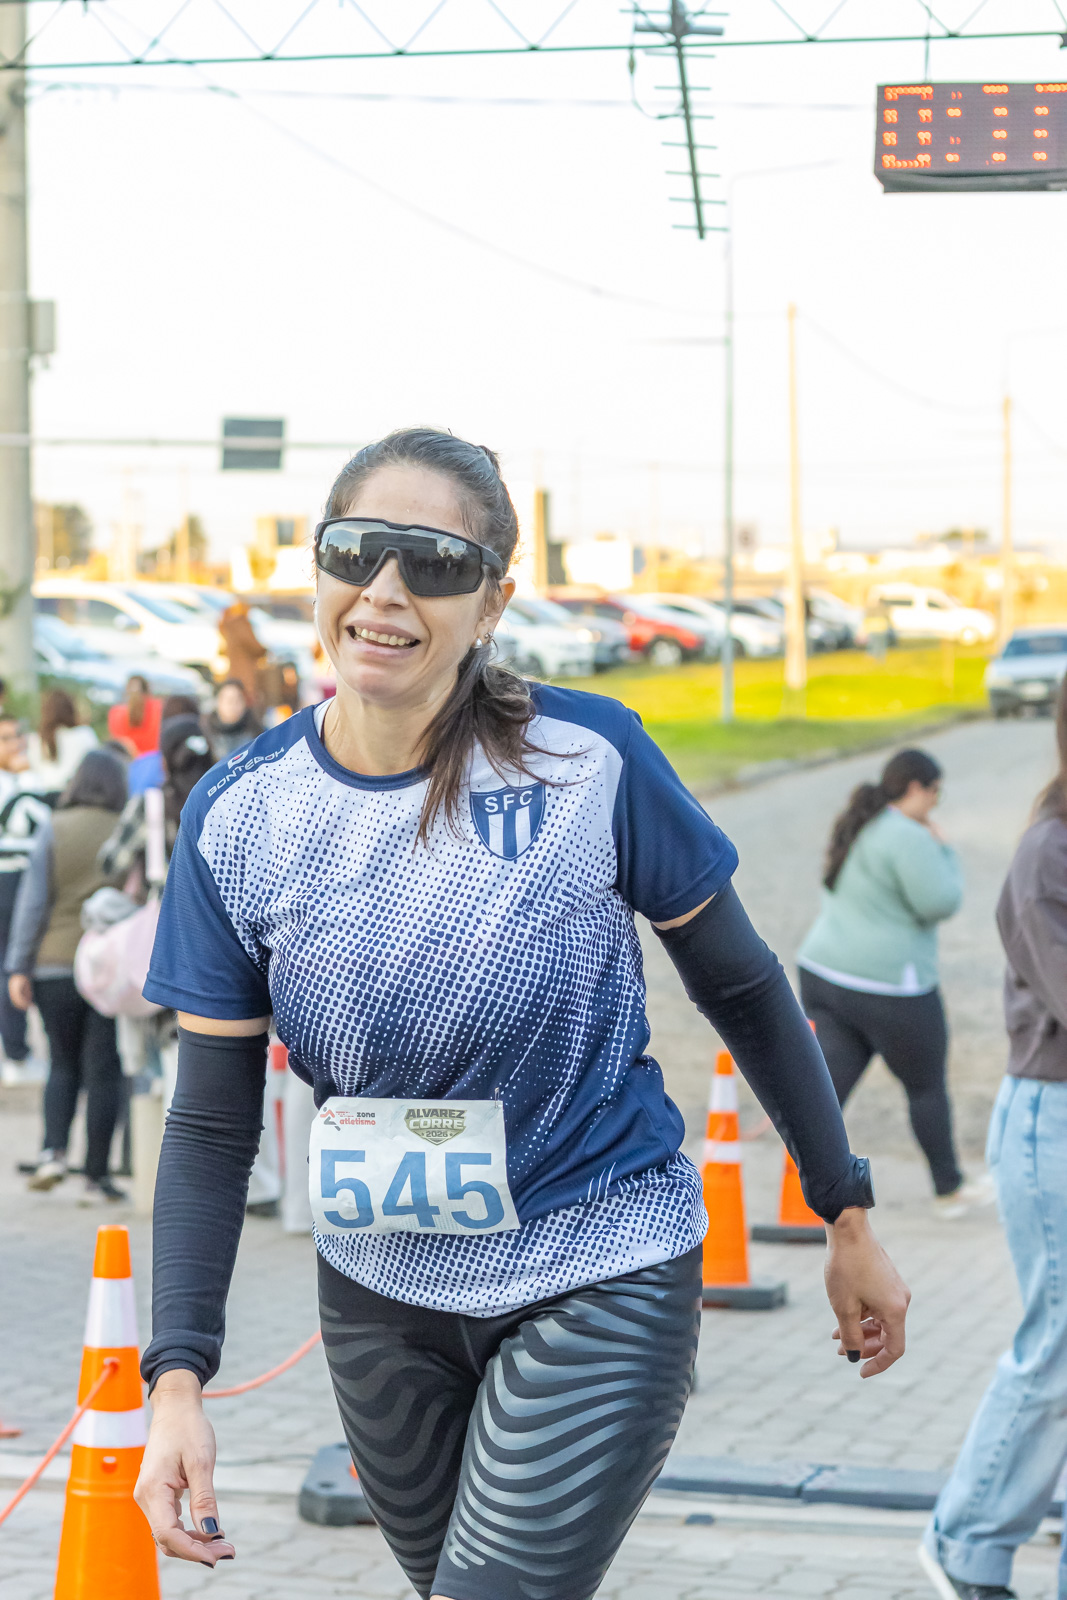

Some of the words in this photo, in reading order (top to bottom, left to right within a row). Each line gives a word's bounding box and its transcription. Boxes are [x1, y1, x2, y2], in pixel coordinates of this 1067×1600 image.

[484, 790, 533, 813] SFC
[405, 1108, 466, 1120] ALVAREZ
[339, 1117, 376, 1126] atletismo
[408, 1118, 465, 1130] CORRE
[320, 1149, 506, 1230] 545
